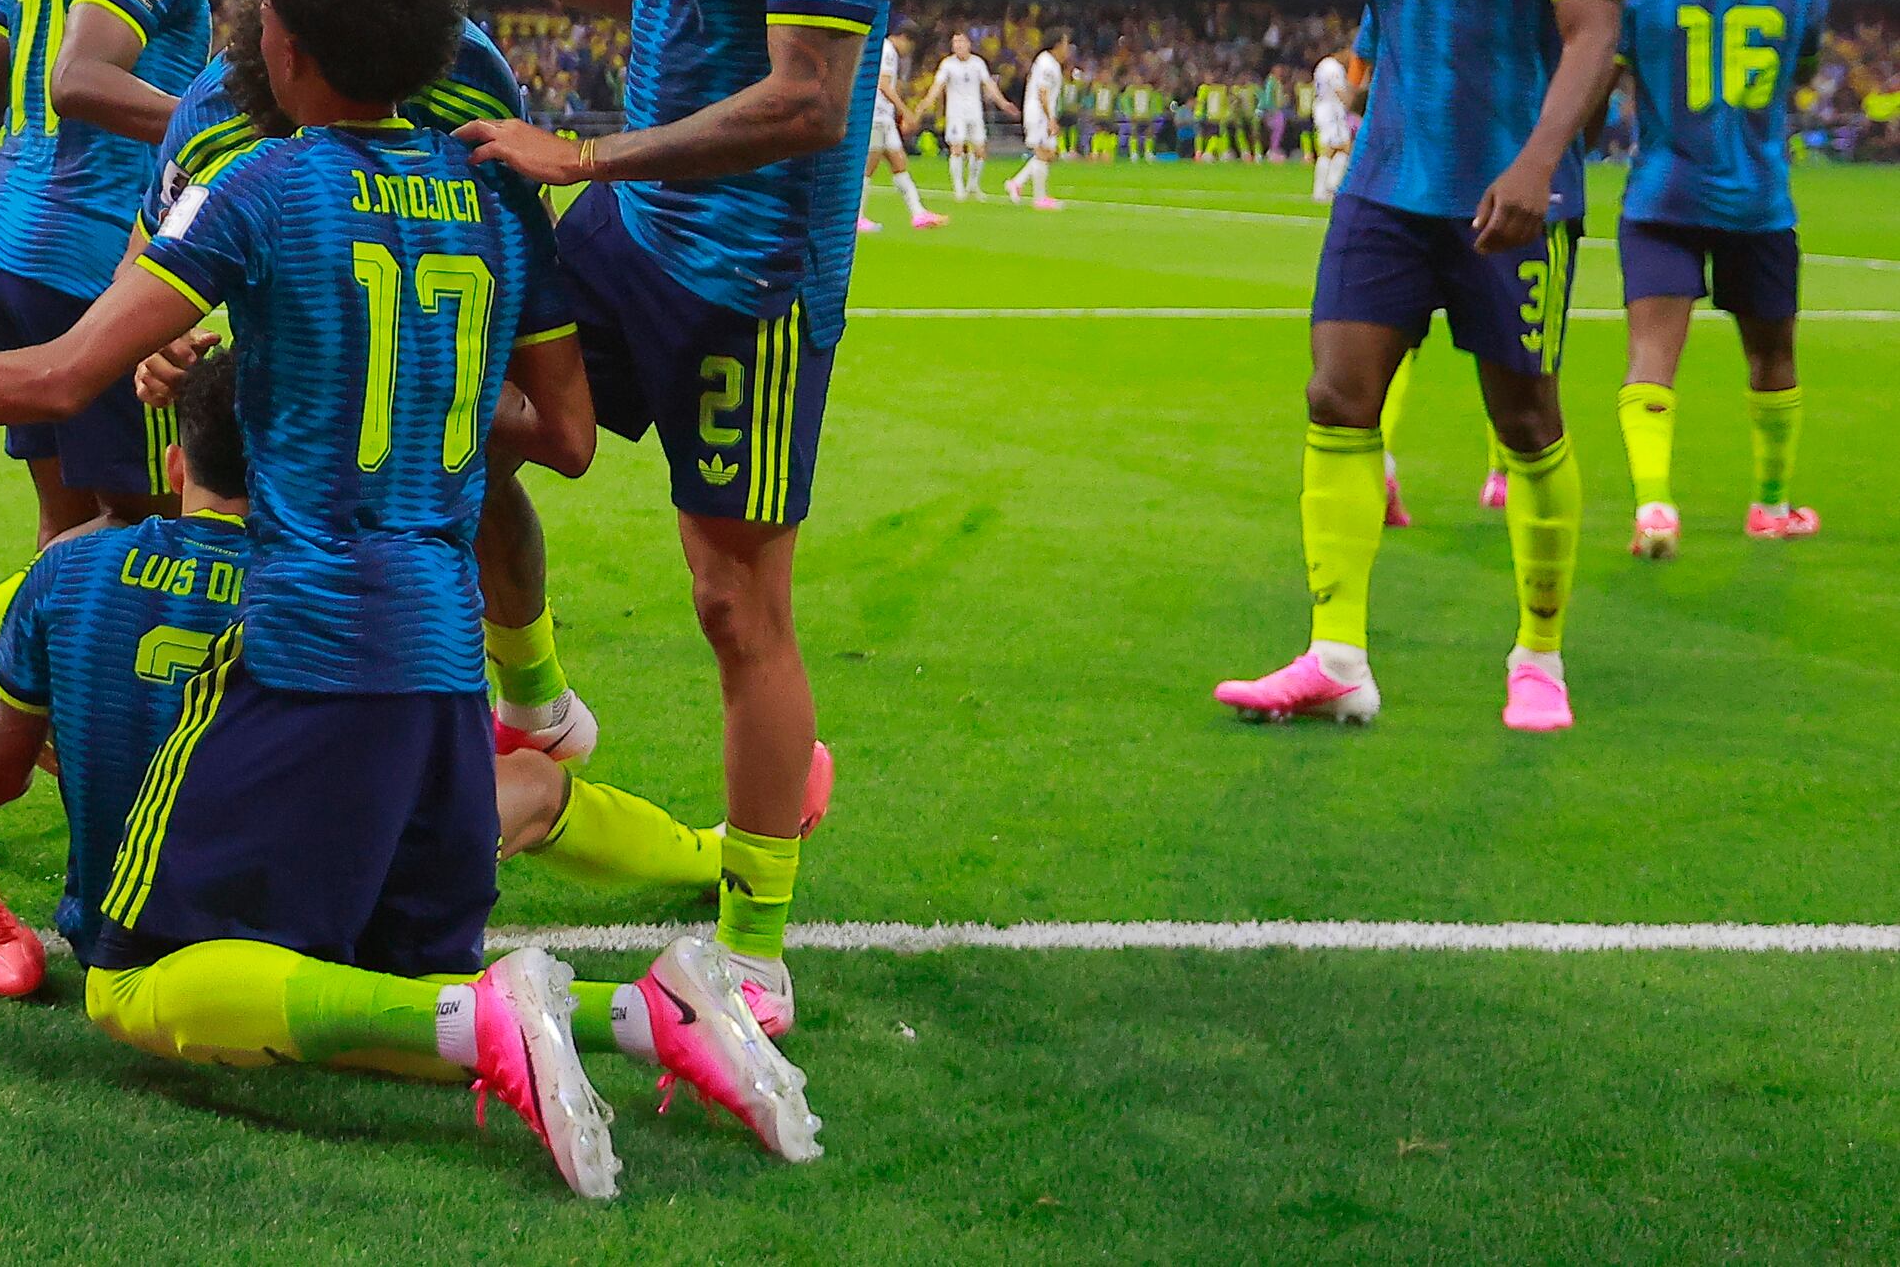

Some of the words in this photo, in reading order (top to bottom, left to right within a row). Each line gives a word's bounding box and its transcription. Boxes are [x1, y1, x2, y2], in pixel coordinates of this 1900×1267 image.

[1676, 4, 1787, 113] 16
[351, 170, 482, 223] J.MOJICA
[1517, 260, 1549, 324] 3
[352, 241, 495, 474] 17
[698, 354, 745, 446] 2
[120, 547, 197, 596] LUIS
[206, 561, 246, 606] DI
